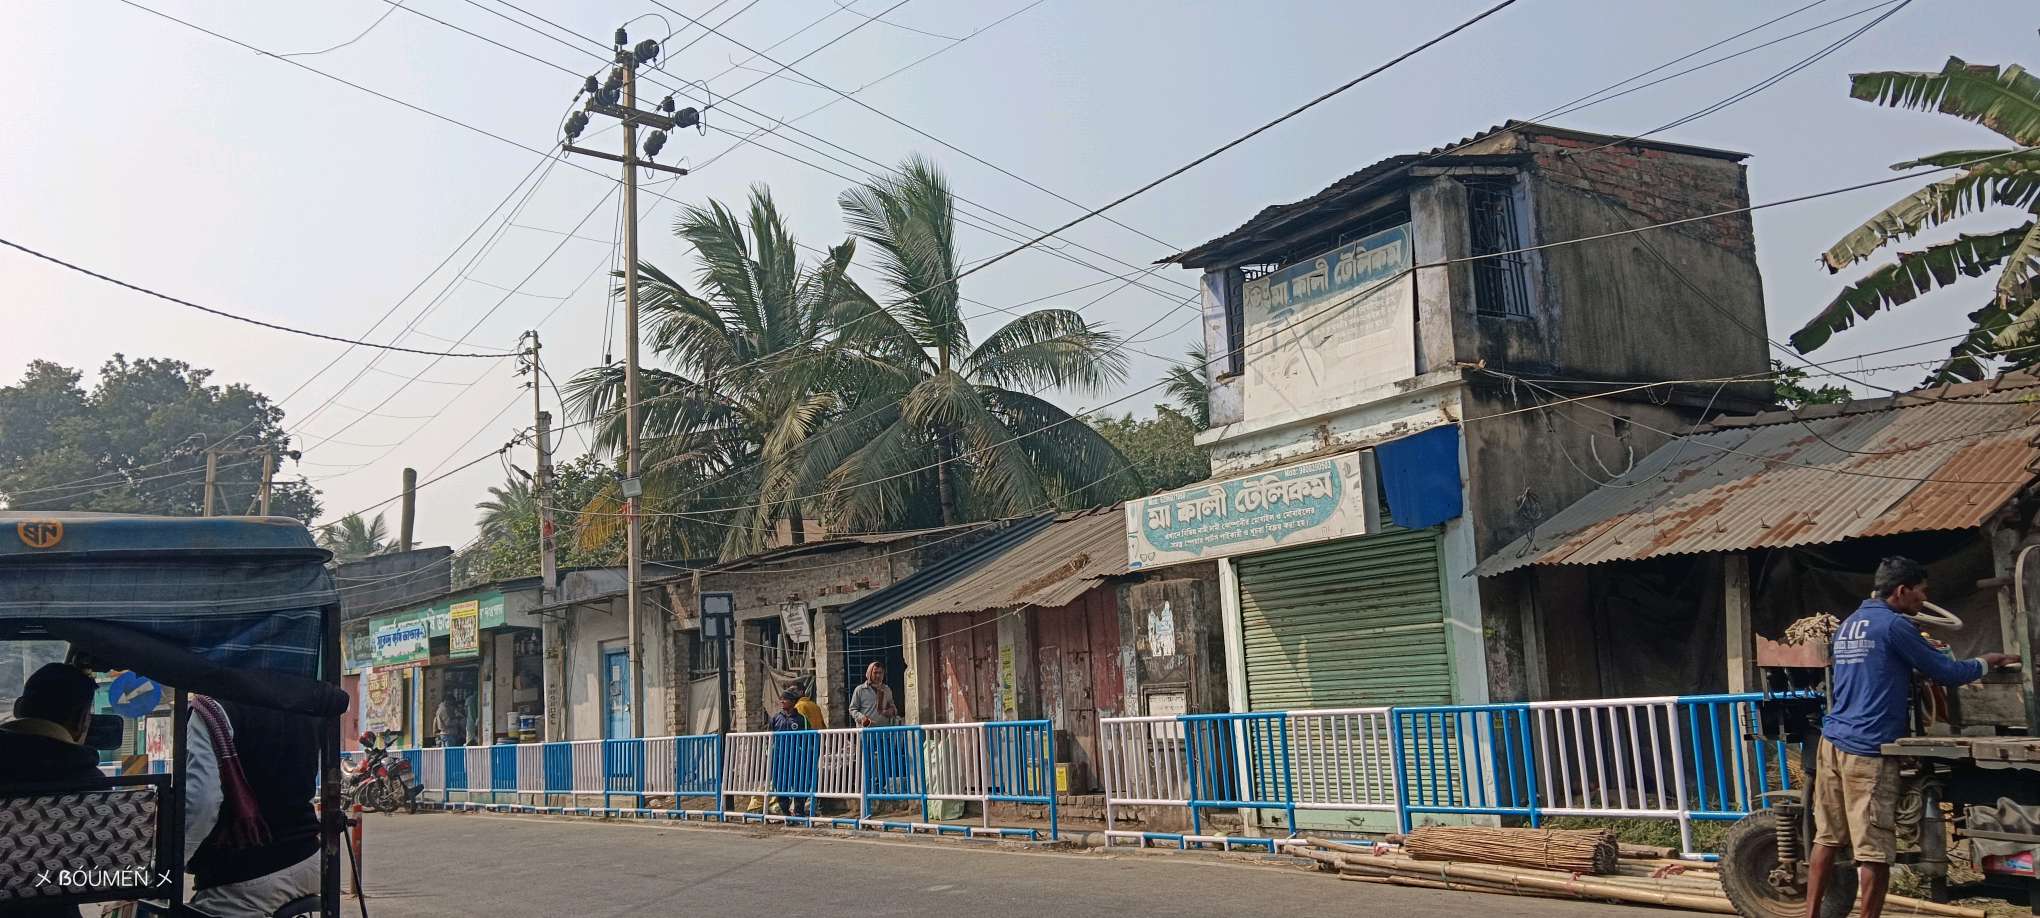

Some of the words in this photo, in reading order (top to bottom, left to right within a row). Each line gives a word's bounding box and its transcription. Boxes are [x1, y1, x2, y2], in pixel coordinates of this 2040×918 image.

[1270, 280, 1289, 305] মা
[1291, 258, 1329, 297] কালী
[1147, 504, 1172, 530] মা
[1177, 487, 1228, 524] কালী
[1235, 472, 1334, 513] টেলিকম
[1838, 619, 1870, 640] LIC
